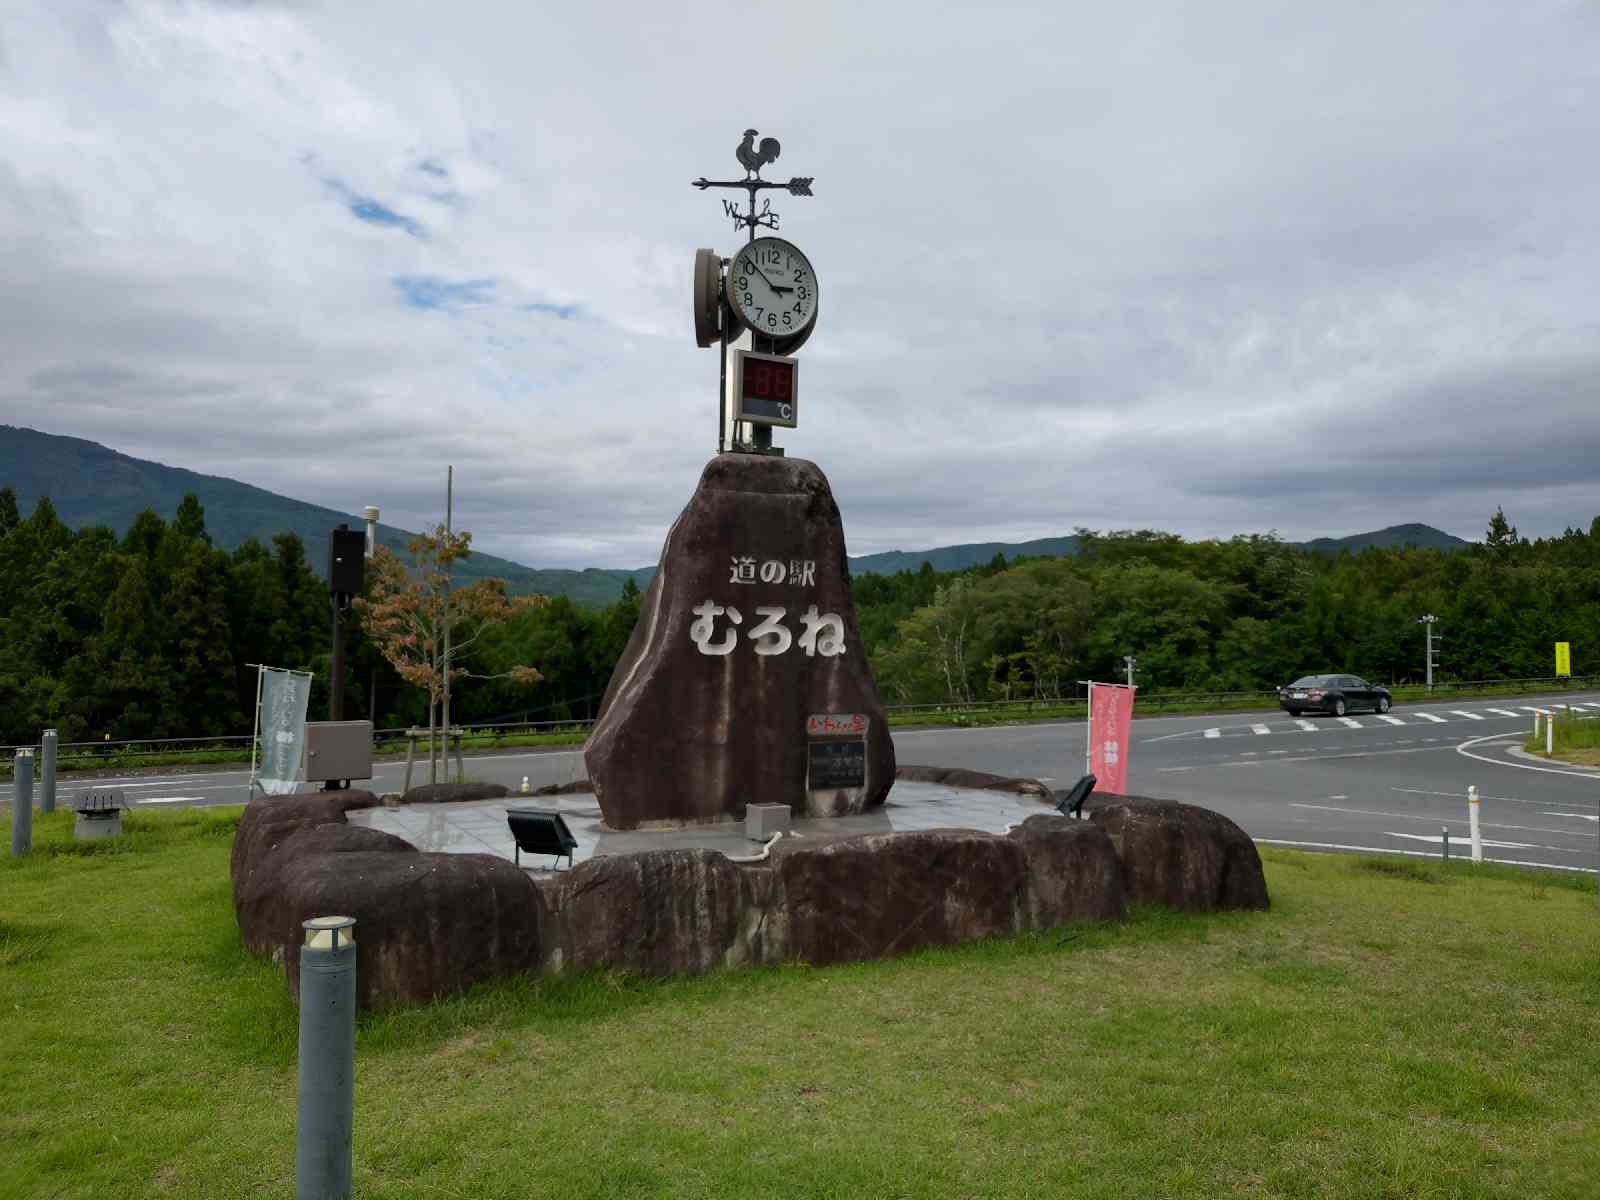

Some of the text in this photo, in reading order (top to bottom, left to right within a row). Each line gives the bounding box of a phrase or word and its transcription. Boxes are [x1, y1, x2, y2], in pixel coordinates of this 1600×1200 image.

[722, 200, 738, 217] W
[768, 210, 779, 230] E
[754, 248, 765, 265] 11
[768, 249, 780, 264] 12
[743, 261, 755, 275] 10
[794, 269, 802, 283] 2
[739, 277, 748, 290] 9
[744, 292, 753, 307] 8
[797, 286, 806, 300] 3
[754, 307, 764, 320] 7
[793, 302, 802, 315] 4
[768, 313, 777, 326] 6
[782, 312, 791, 325] 5
[729, 555, 816, 587] 道の駅
[690, 600, 847, 657] むろね
